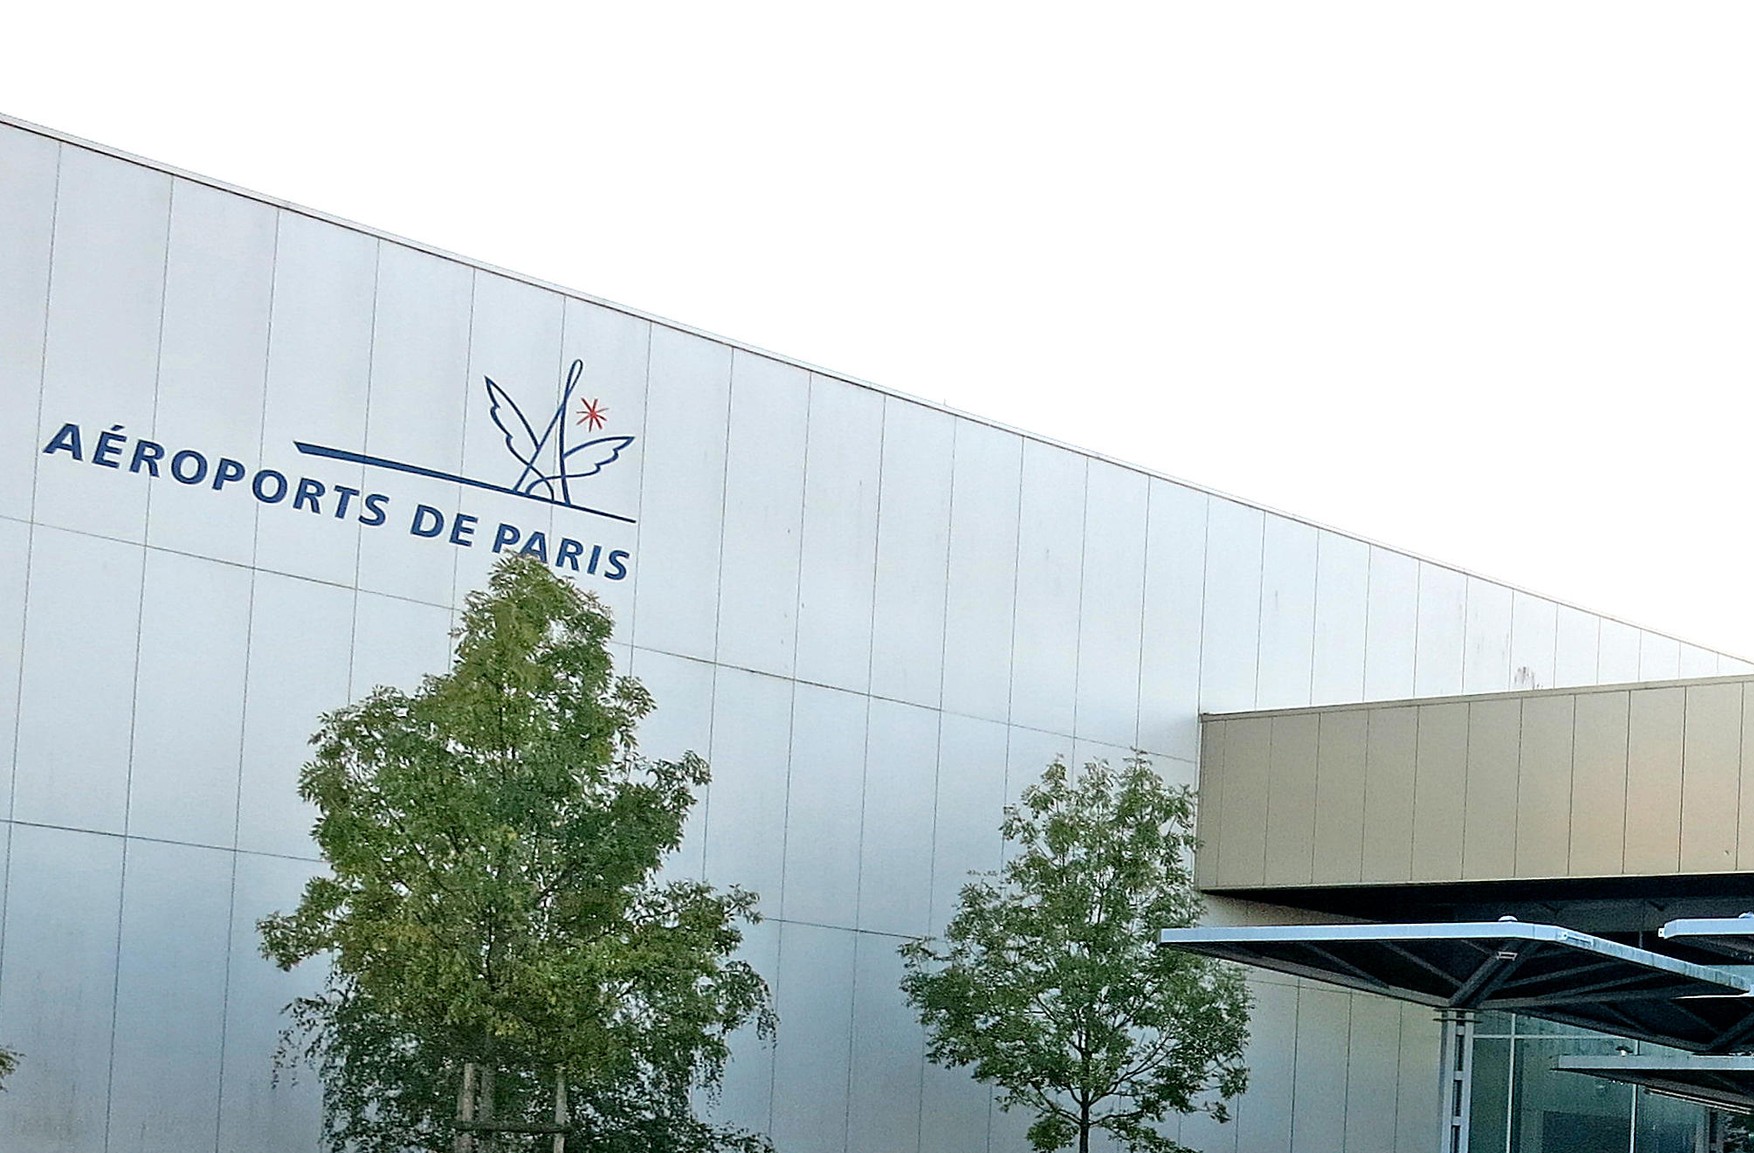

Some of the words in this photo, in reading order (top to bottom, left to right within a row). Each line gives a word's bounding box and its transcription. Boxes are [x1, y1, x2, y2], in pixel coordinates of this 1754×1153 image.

[43, 423, 390, 526] AÉROPORTS
[410, 504, 478, 547] DE
[492, 523, 630, 581] PARIS
